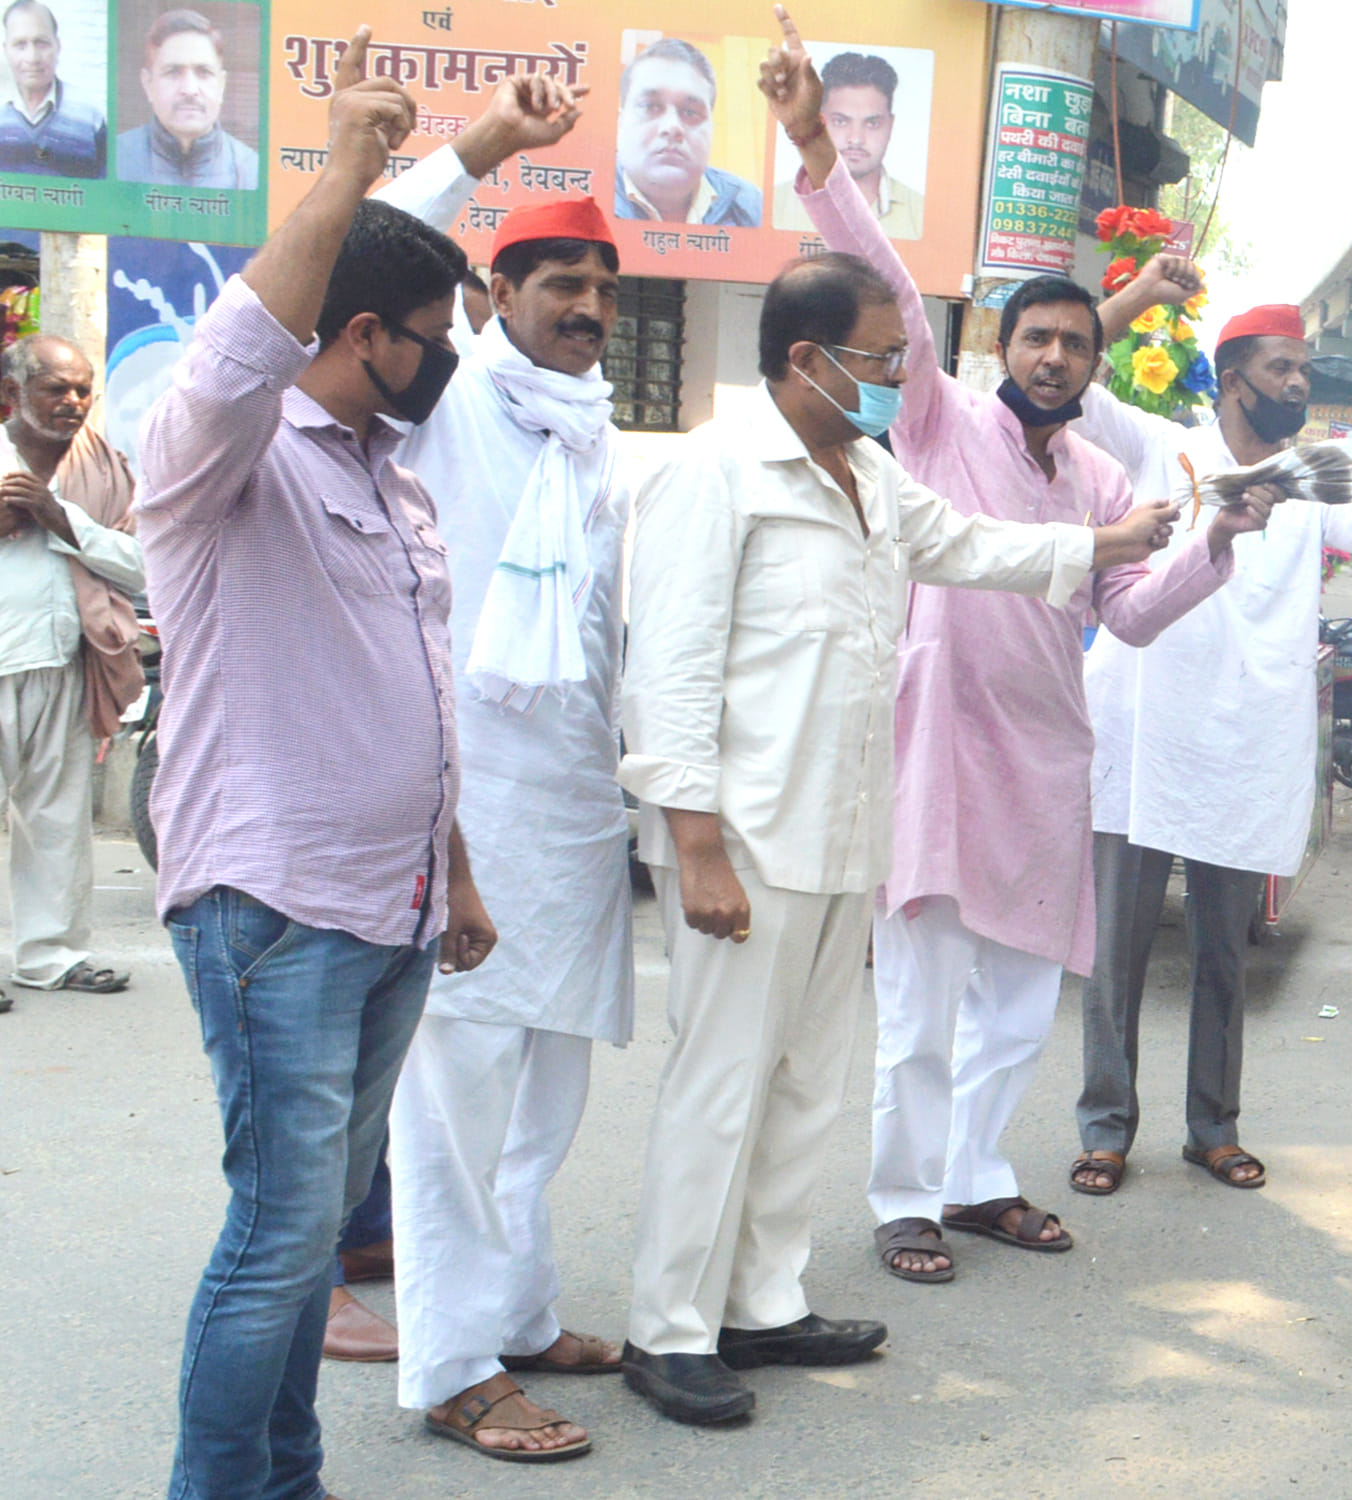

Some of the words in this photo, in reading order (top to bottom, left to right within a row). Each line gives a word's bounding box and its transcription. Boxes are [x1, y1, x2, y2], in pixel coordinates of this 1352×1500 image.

[422, 8, 453, 31] एवं
[1005, 83, 1052, 103] नशा
[1003, 103, 1053, 128] बिना
